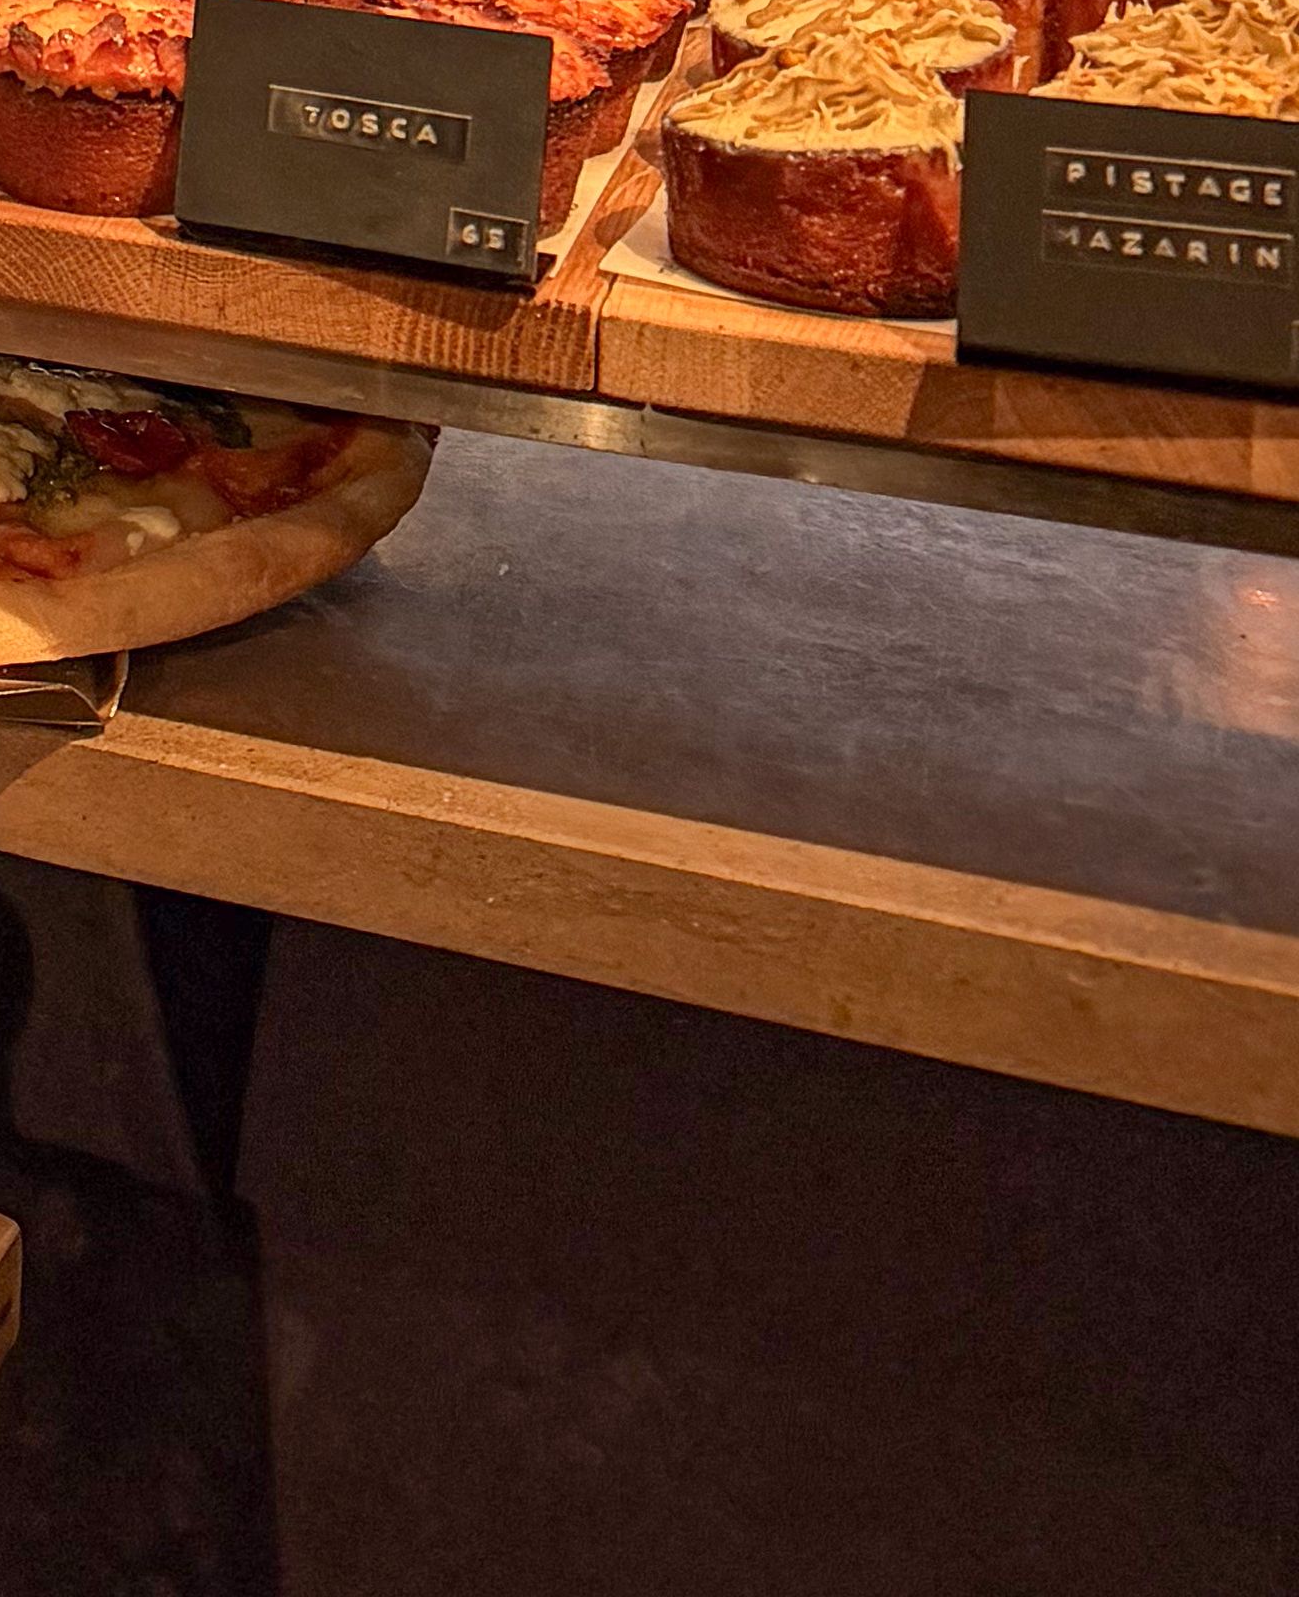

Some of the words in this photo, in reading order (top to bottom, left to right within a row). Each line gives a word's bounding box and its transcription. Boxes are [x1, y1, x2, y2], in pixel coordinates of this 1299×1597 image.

[304, 105, 438, 145] TOSCA
[1066, 160, 1283, 206] PISTAGE
[1057, 226, 1281, 270] MAZARIN
